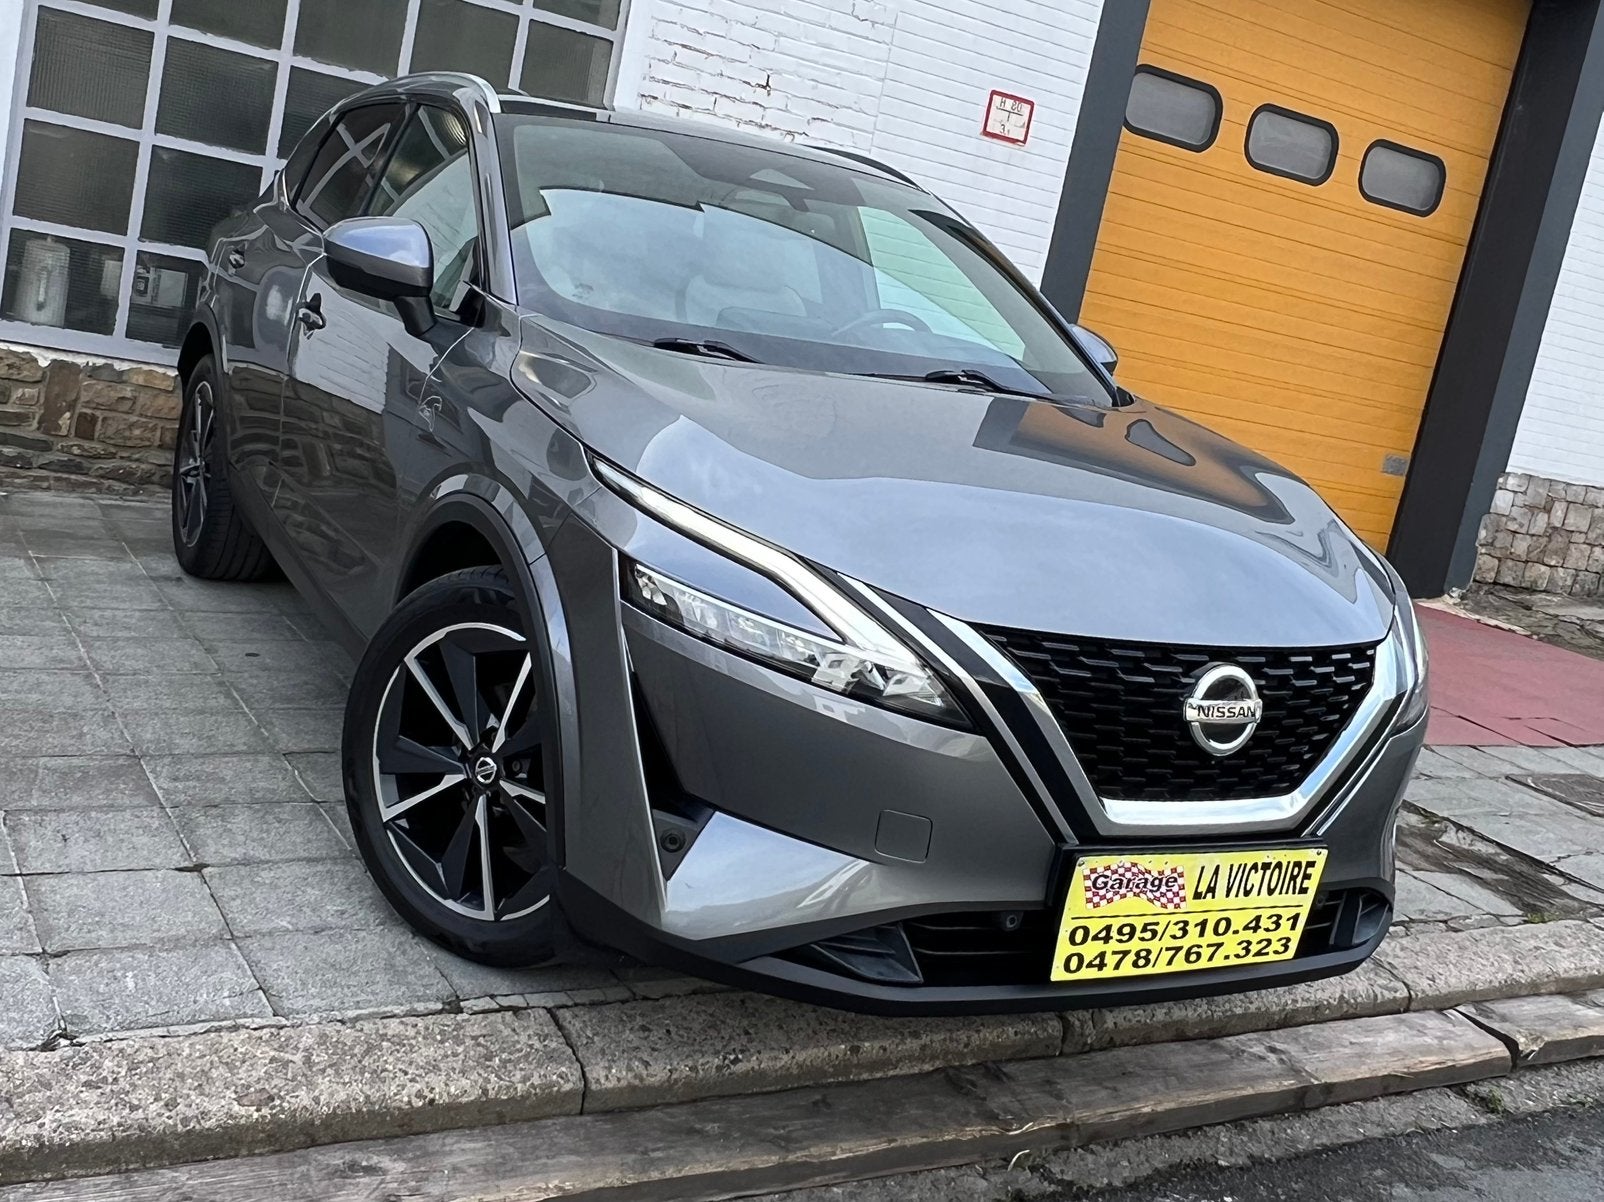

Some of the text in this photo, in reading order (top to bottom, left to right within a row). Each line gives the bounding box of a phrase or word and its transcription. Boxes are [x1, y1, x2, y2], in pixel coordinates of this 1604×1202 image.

[1000, 97, 1006, 108] H
[1197, 706, 1256, 718] NISSAN
[1091, 860, 1317, 900] Garage LA VICTOIRE
[1068, 912, 1301, 947] 0495/310.431
[1063, 936, 1292, 974] 0478/767.323
